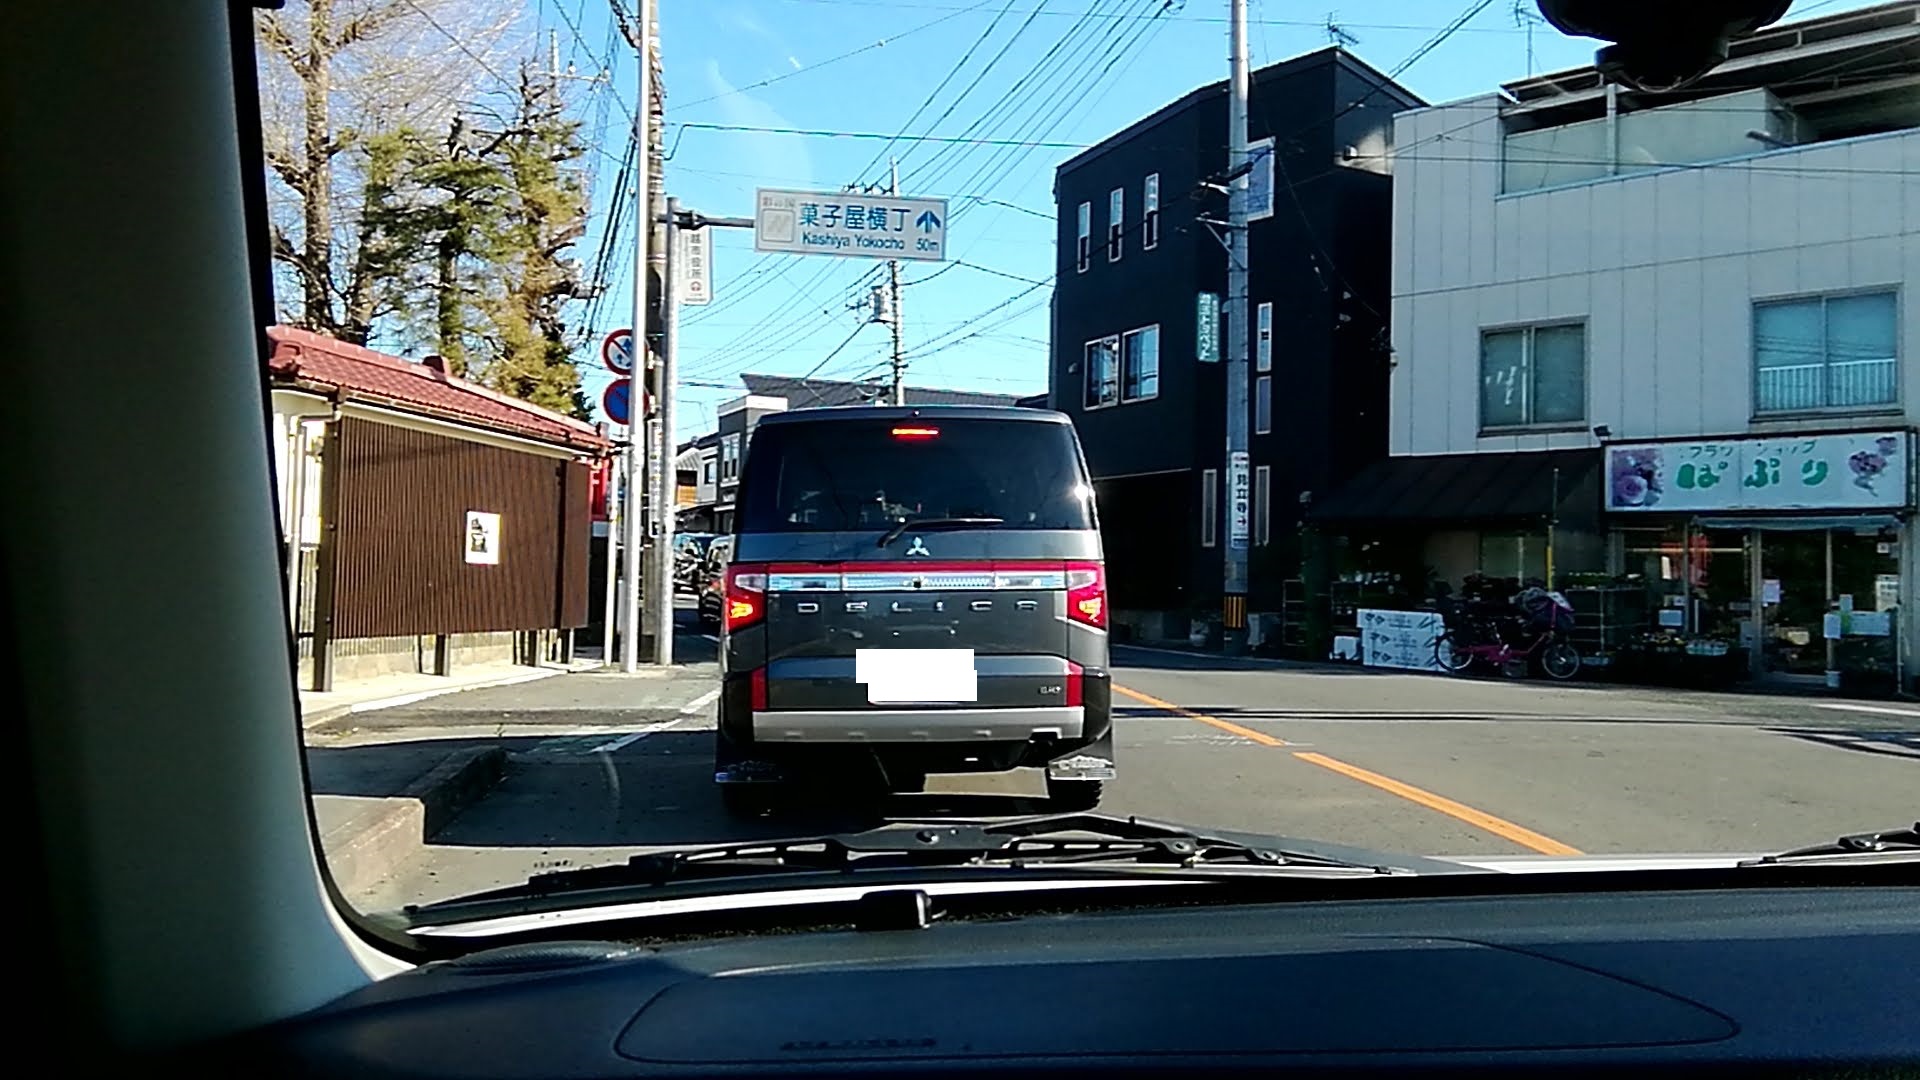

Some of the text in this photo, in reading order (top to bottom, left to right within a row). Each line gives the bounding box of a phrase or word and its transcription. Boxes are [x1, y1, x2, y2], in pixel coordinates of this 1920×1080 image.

[800, 203, 911, 233] 菓子屋横丁
[802, 231, 940, 252] Kashiya Yokocho 50m
[690, 233, 702, 279] 越市役所
[797, 601, 1038, 613] DELICA
